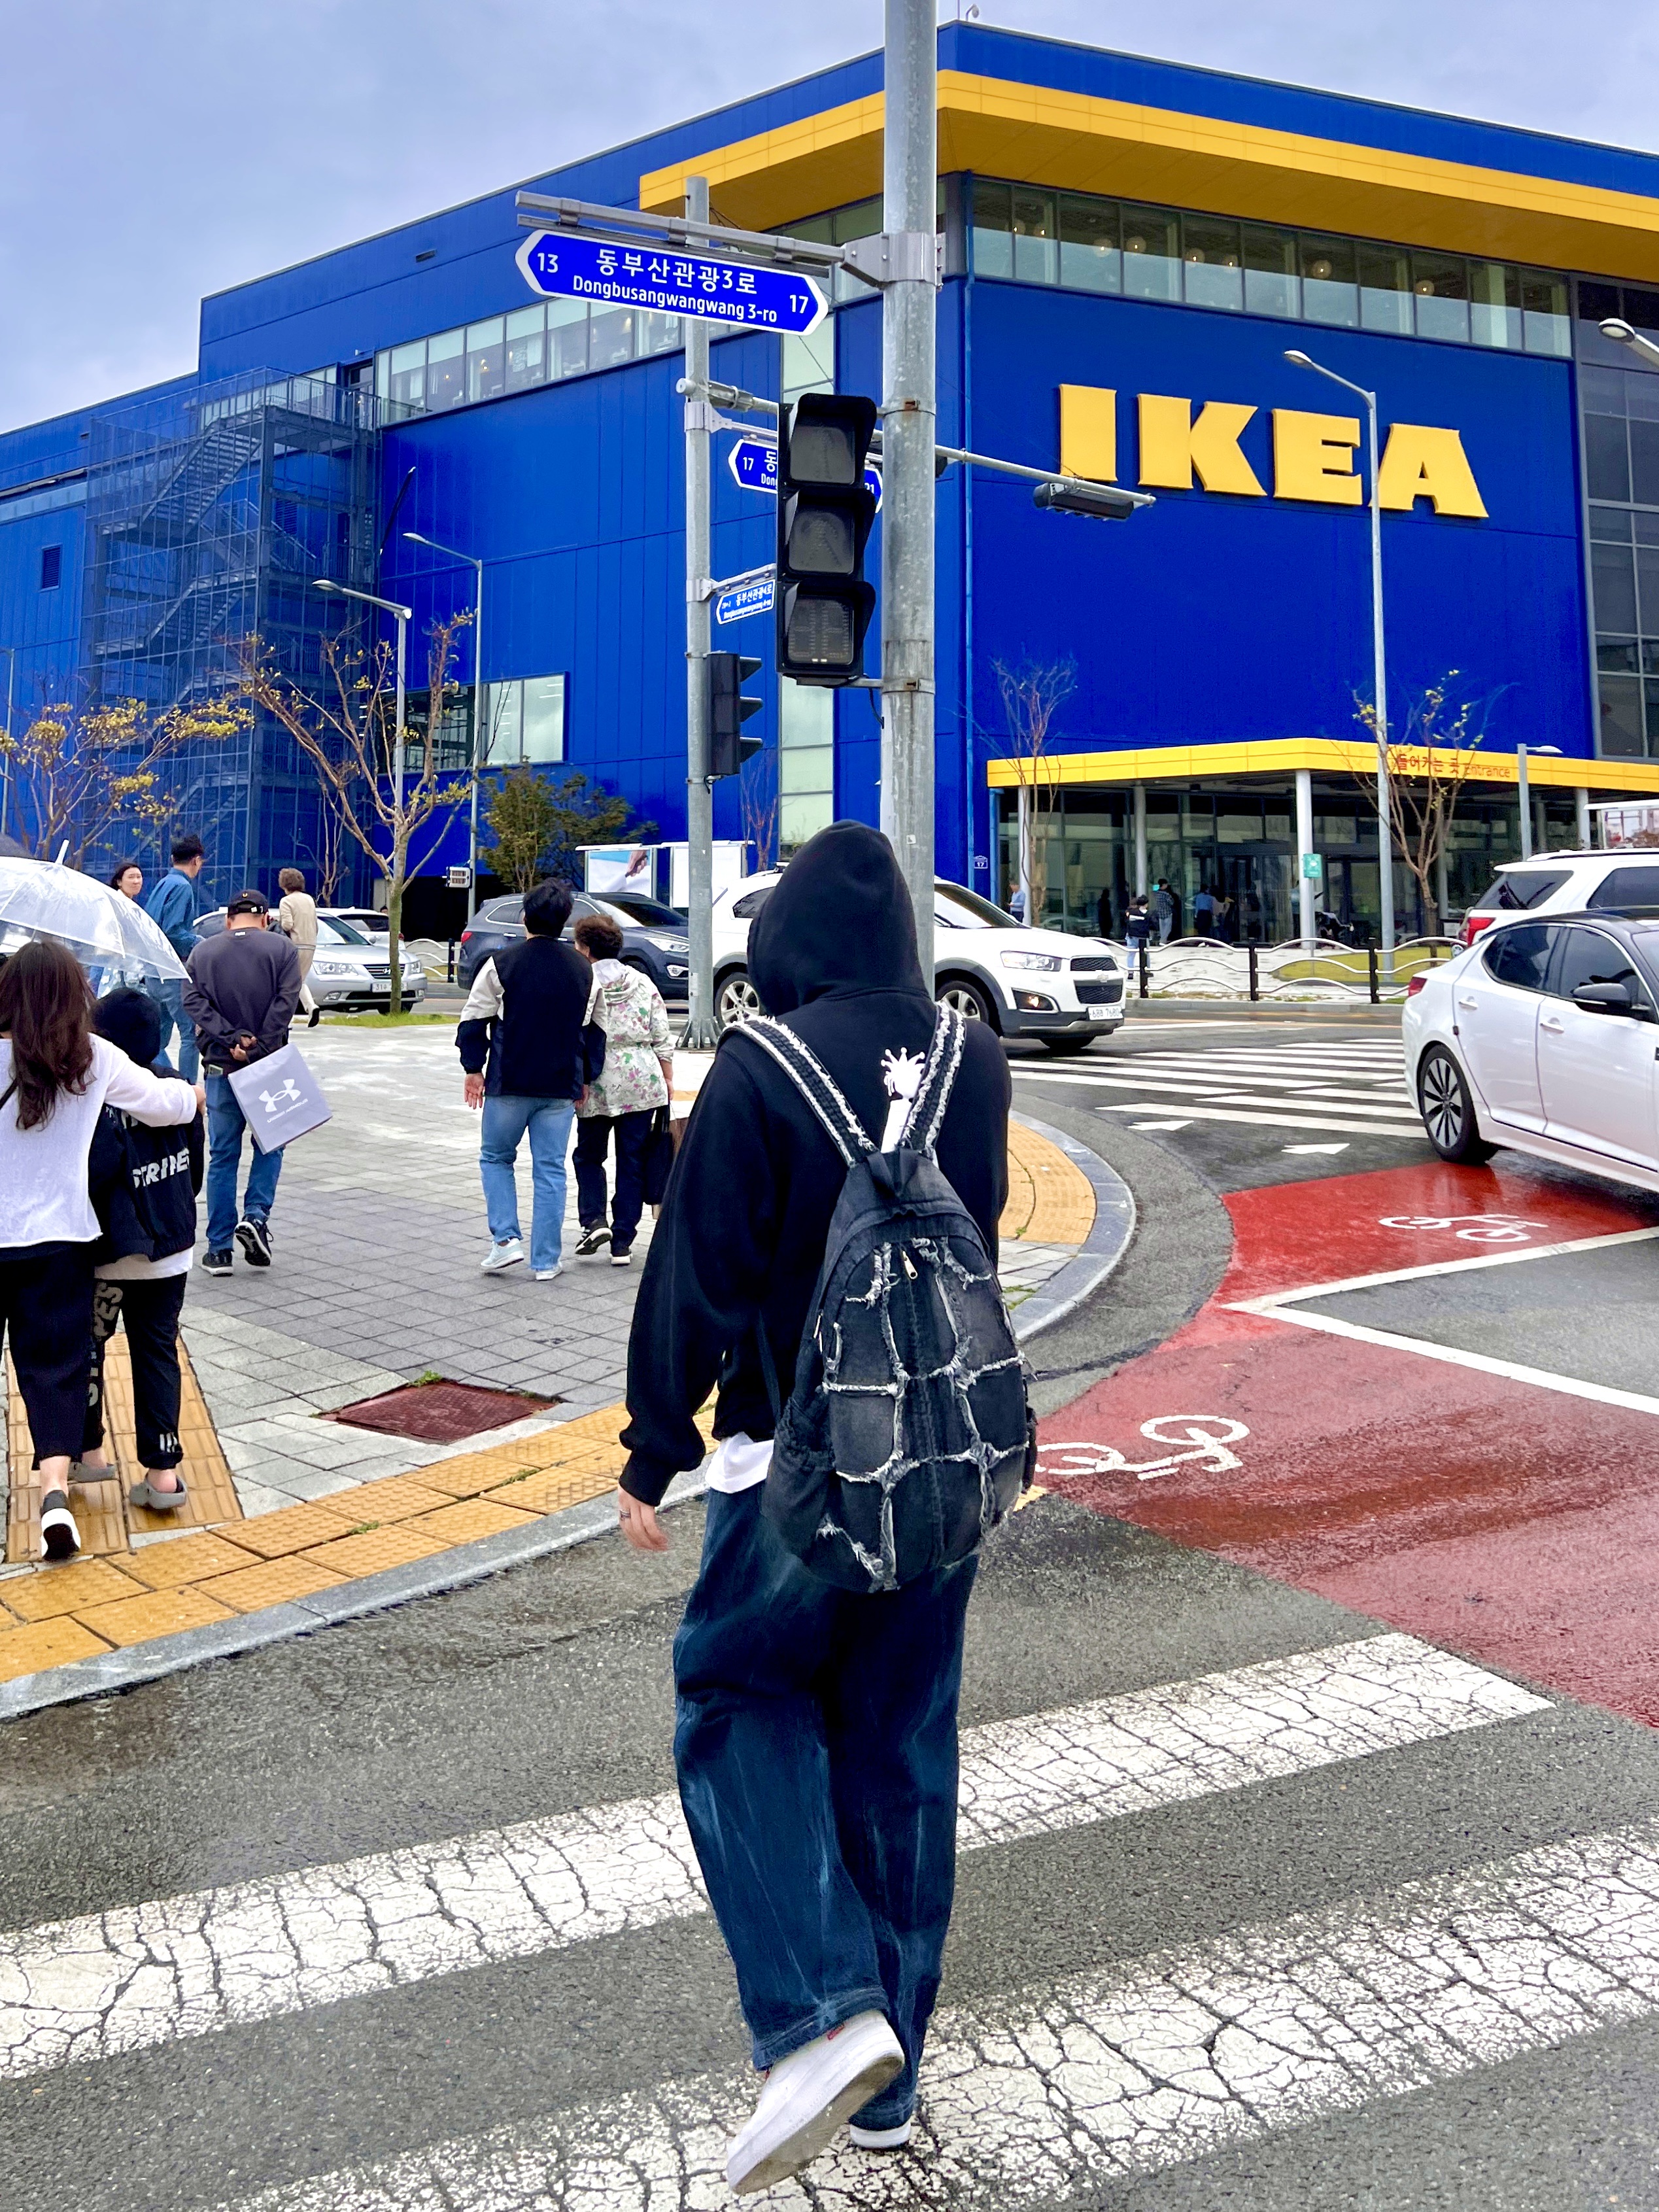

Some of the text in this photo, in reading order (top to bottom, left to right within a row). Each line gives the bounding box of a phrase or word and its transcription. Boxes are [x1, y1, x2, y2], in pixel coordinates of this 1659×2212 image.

[537, 252, 559, 273] 13
[596, 249, 757, 294] 동부산관광3로
[573, 275, 778, 323] Dongbusangwangwang 3-ro
[789, 294, 809, 314] 17
[743, 457, 755, 471] 17
[1059, 383, 1489, 518] IKEA
